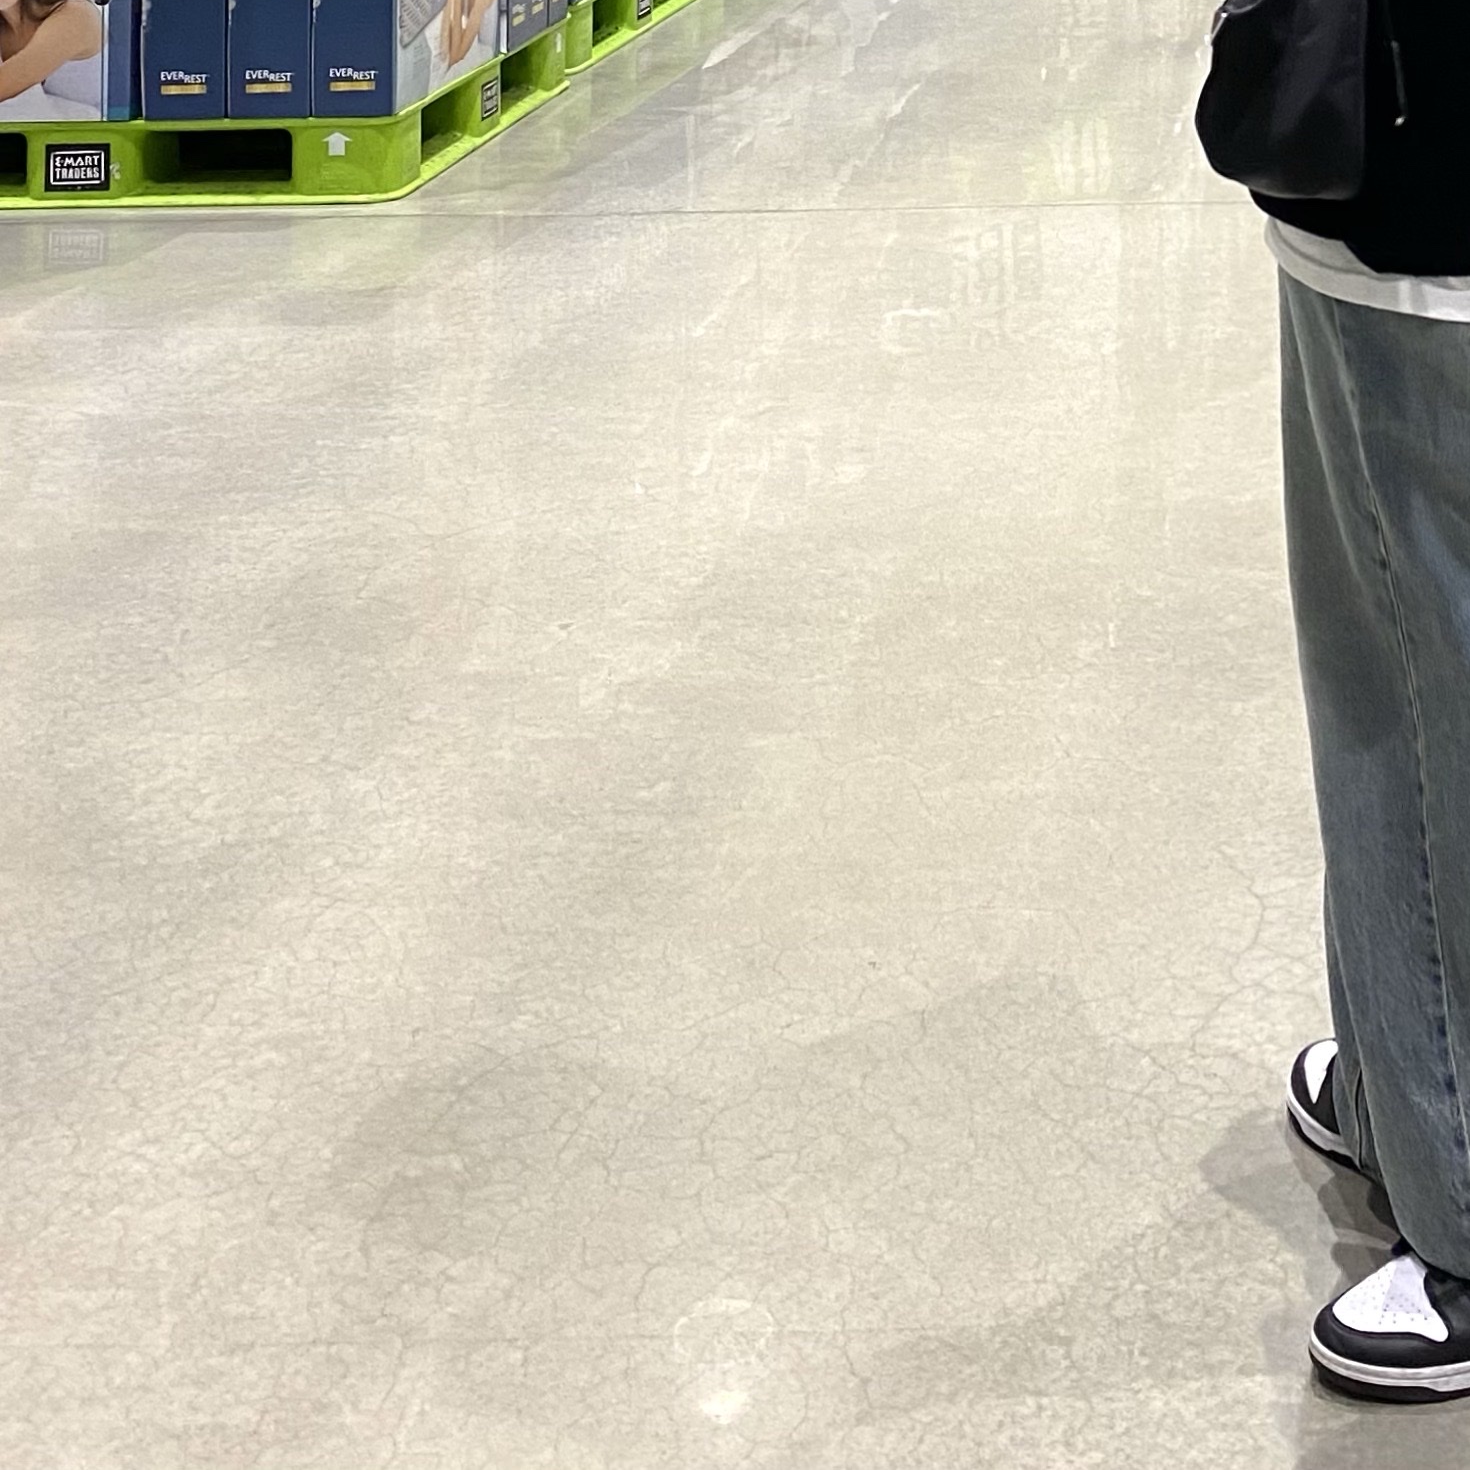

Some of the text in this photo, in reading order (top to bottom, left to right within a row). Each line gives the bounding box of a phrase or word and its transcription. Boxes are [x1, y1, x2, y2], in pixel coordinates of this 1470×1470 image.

[160, 71, 207, 84] EVERREST
[245, 69, 292, 82] EVERREST
[329, 68, 376, 80] EVERREST
[55, 167, 100, 179] TRADERS
